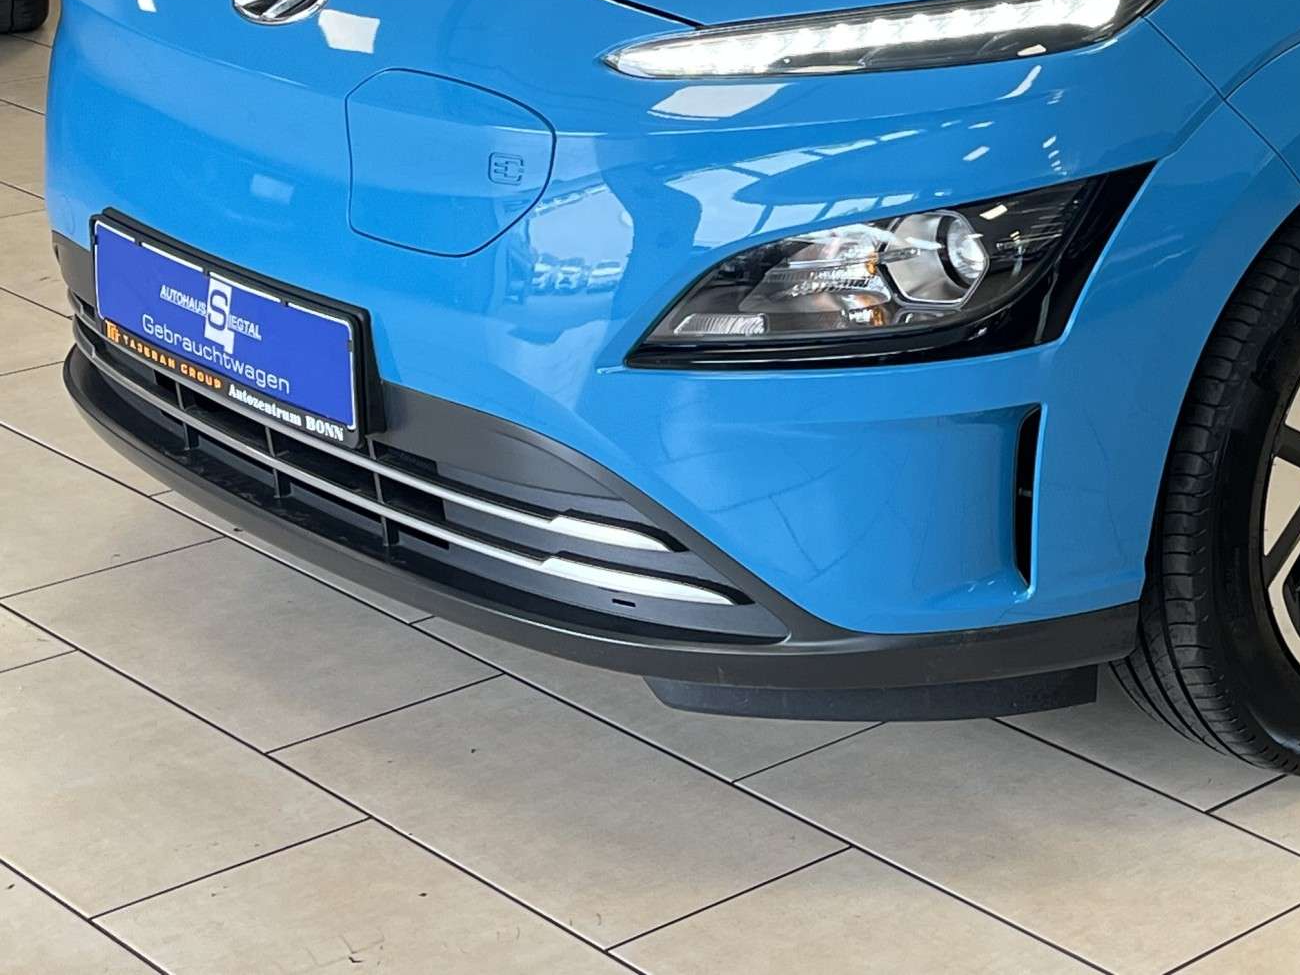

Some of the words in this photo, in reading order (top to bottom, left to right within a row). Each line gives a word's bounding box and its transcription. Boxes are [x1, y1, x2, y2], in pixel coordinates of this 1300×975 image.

[160, 284, 207, 316] AUTOHAUS
[142, 313, 290, 395] Gebrauchtwagen
[180, 363, 222, 389] GROUP
[228, 384, 302, 427] Autozentrum
[305, 415, 344, 442] BONN
